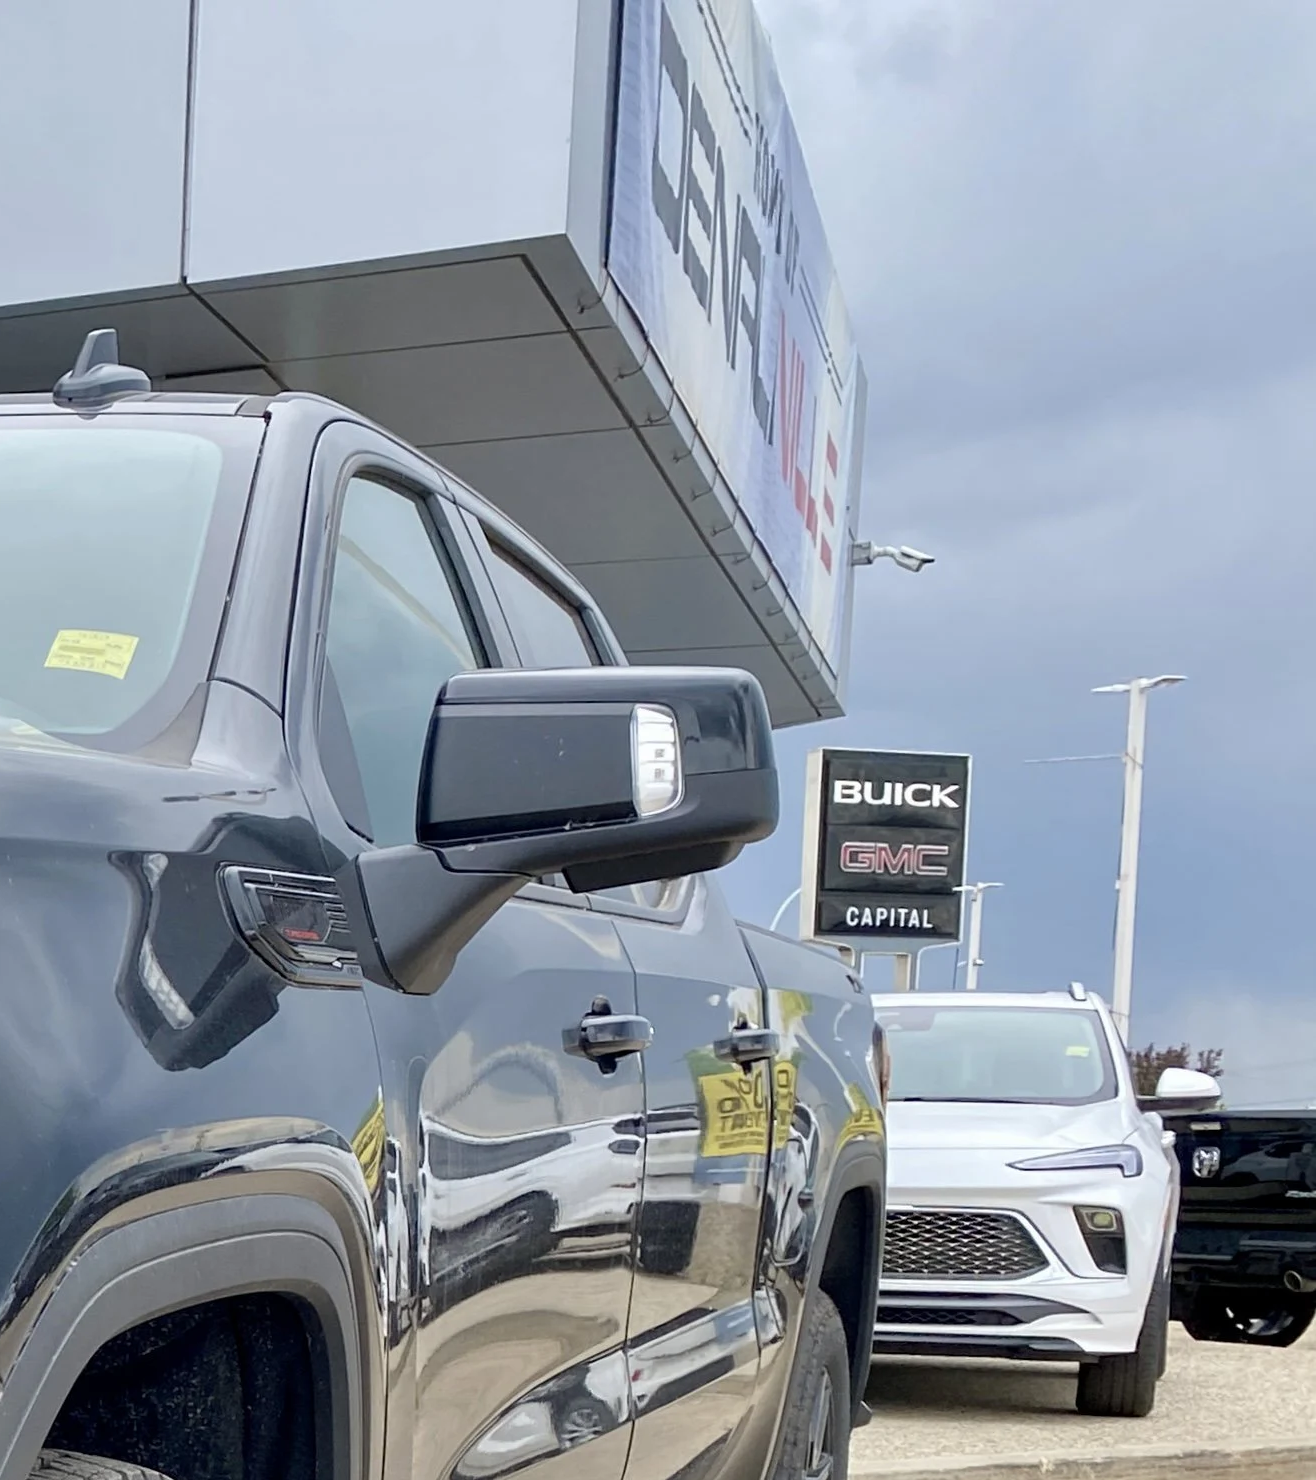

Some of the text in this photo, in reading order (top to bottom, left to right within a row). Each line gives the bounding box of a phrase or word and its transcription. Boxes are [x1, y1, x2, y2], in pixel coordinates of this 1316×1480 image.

[833, 780, 960, 808] BUICK
[840, 841, 949, 876] GMC
[846, 906, 933, 928] CAPITAL
